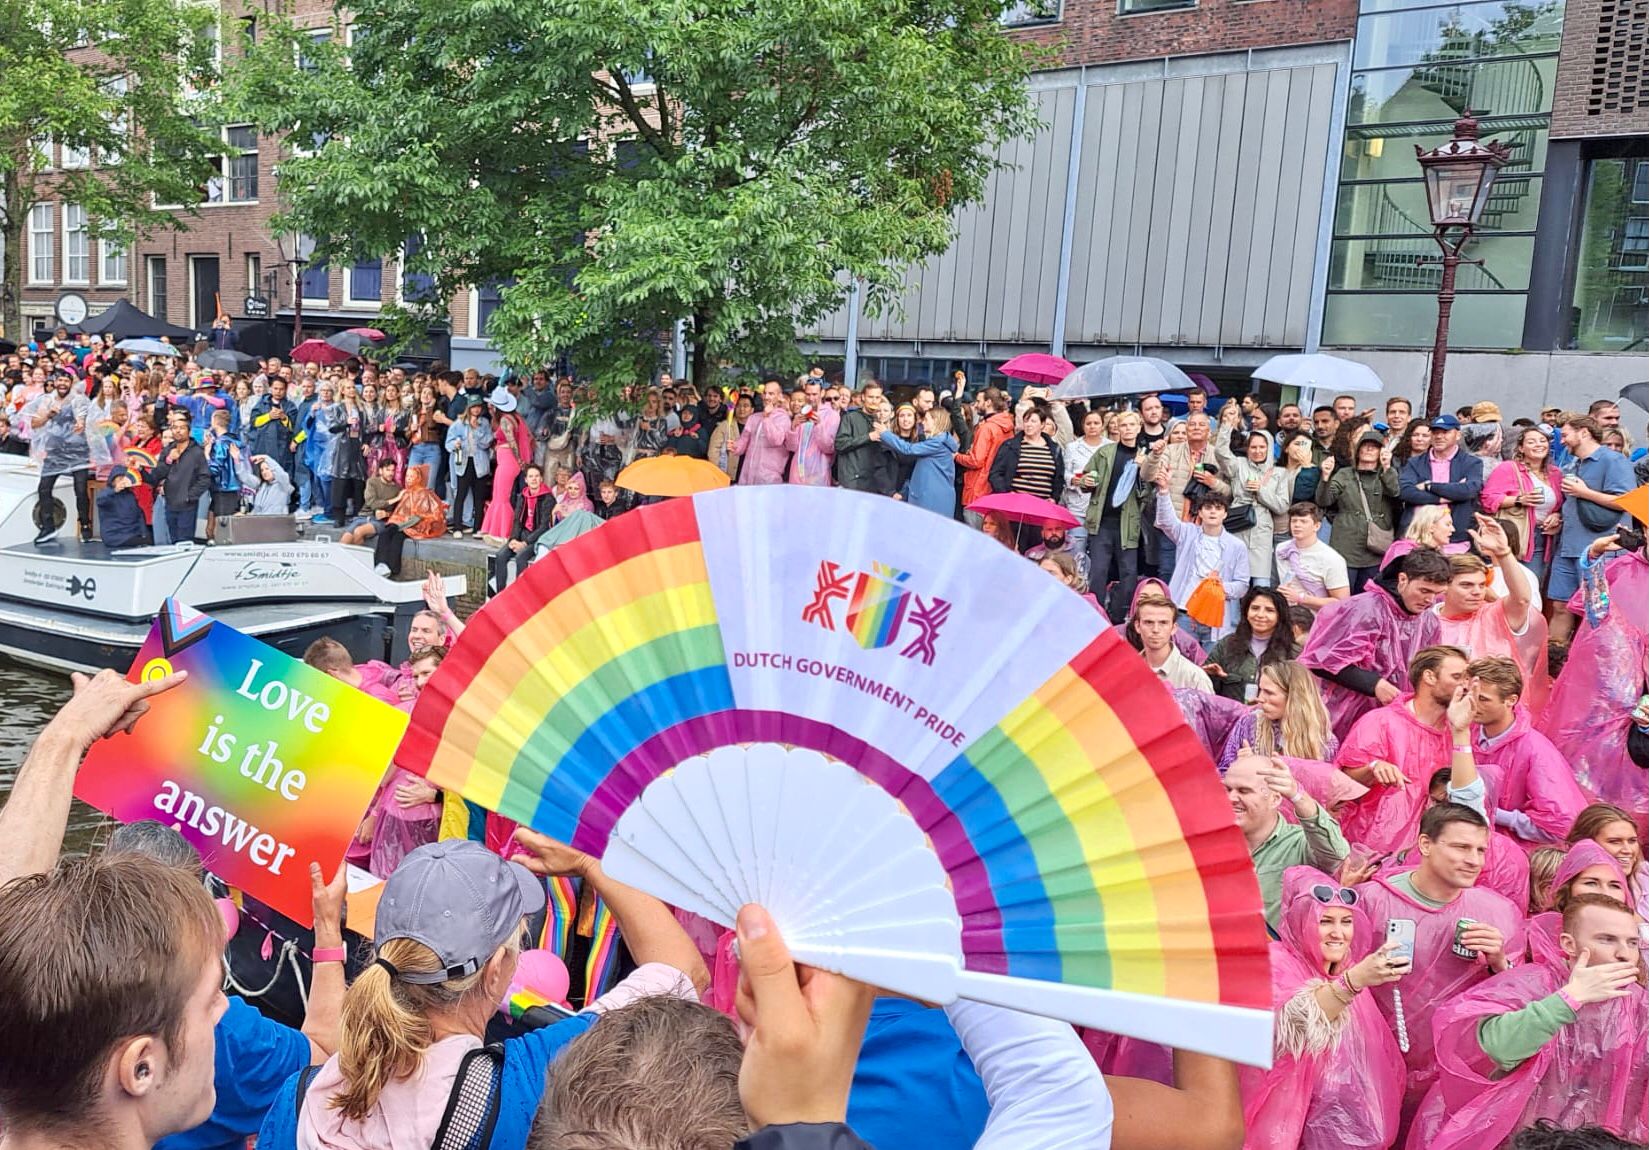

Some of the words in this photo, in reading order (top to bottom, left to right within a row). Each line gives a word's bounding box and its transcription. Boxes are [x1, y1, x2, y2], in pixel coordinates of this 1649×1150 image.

[236, 658, 330, 733] Love
[734, 652, 792, 670] DUTCH
[796, 658, 915, 713] GOVERNMENT
[913, 706, 966, 748] PRIDE
[198, 715, 237, 763] is
[240, 741, 306, 801] the
[153, 780, 296, 876] answer
